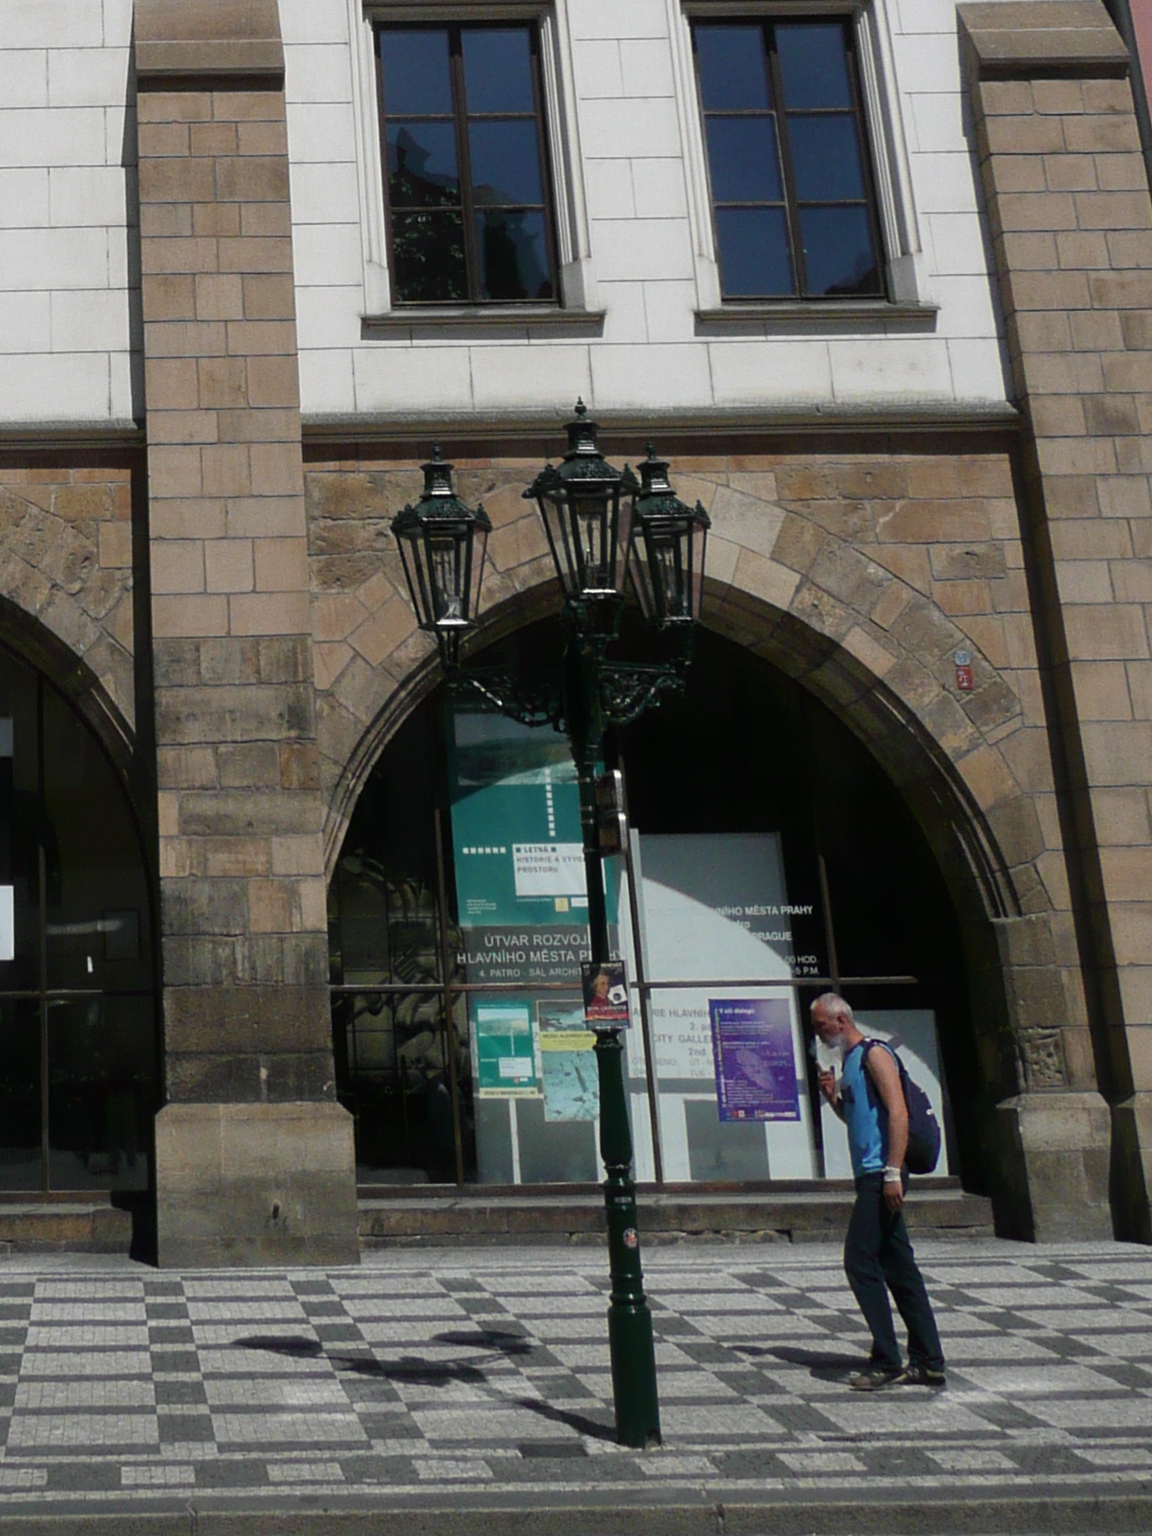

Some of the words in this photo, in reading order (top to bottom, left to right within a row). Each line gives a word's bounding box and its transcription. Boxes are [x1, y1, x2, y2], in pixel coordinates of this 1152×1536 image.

[524, 845, 548, 853] LETNÁ
[745, 904, 779, 915] MĚSTA
[780, 905, 813, 915] PRAHY
[484, 933, 529, 947] ÚTVAR
[457, 949, 526, 964] HLAVNÍHO
[530, 948, 575, 962] MĚSTA
[490, 969, 520, 978] PATRO
[529, 967, 546, 977] SÁL
[669, 1008, 708, 1018] HLAVNÍH
[652, 1034, 673, 1043] CITY
[678, 1034, 711, 1043] GALLE
[688, 1048, 706, 1056] 2nd
